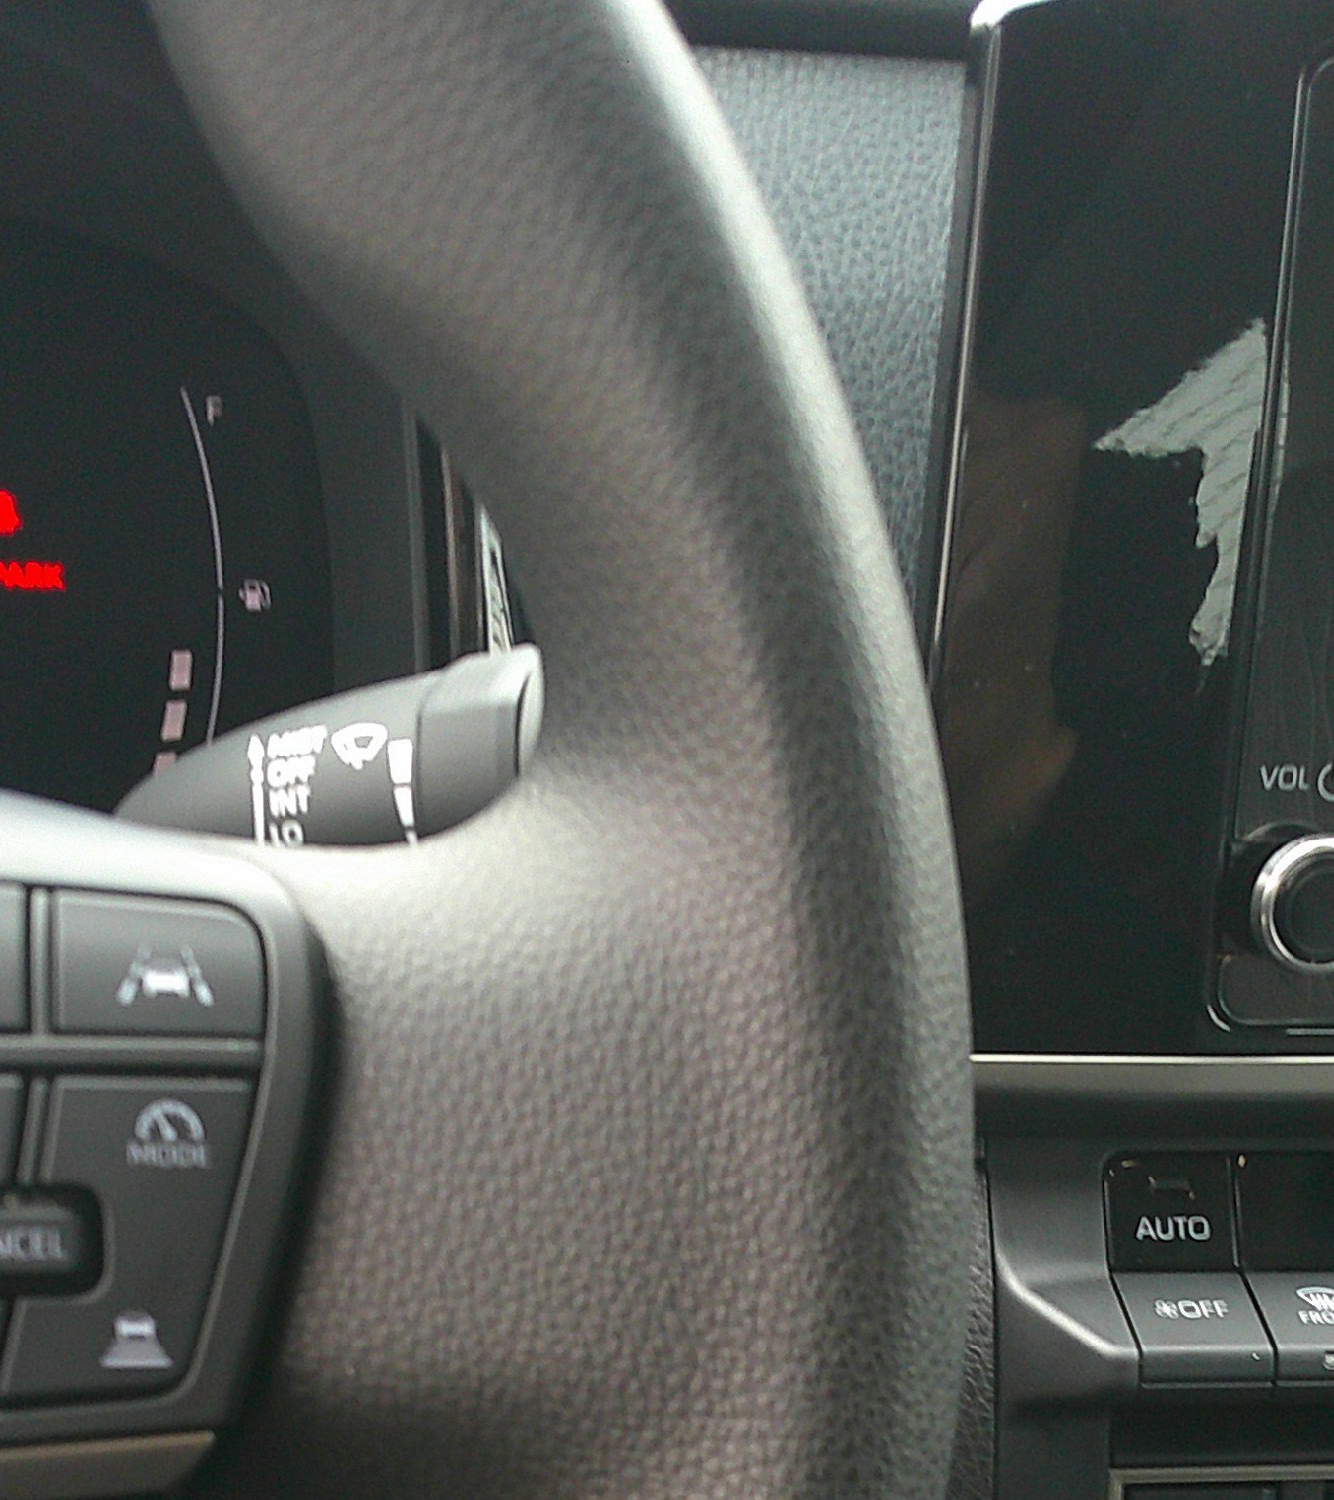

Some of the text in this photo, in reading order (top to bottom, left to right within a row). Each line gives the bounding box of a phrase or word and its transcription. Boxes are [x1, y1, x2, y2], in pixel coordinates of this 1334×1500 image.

[1260, 764, 1308, 792] VOL
[1135, 1215, 1212, 1242] AUTO
[1178, 1300, 1229, 1320] OFF
